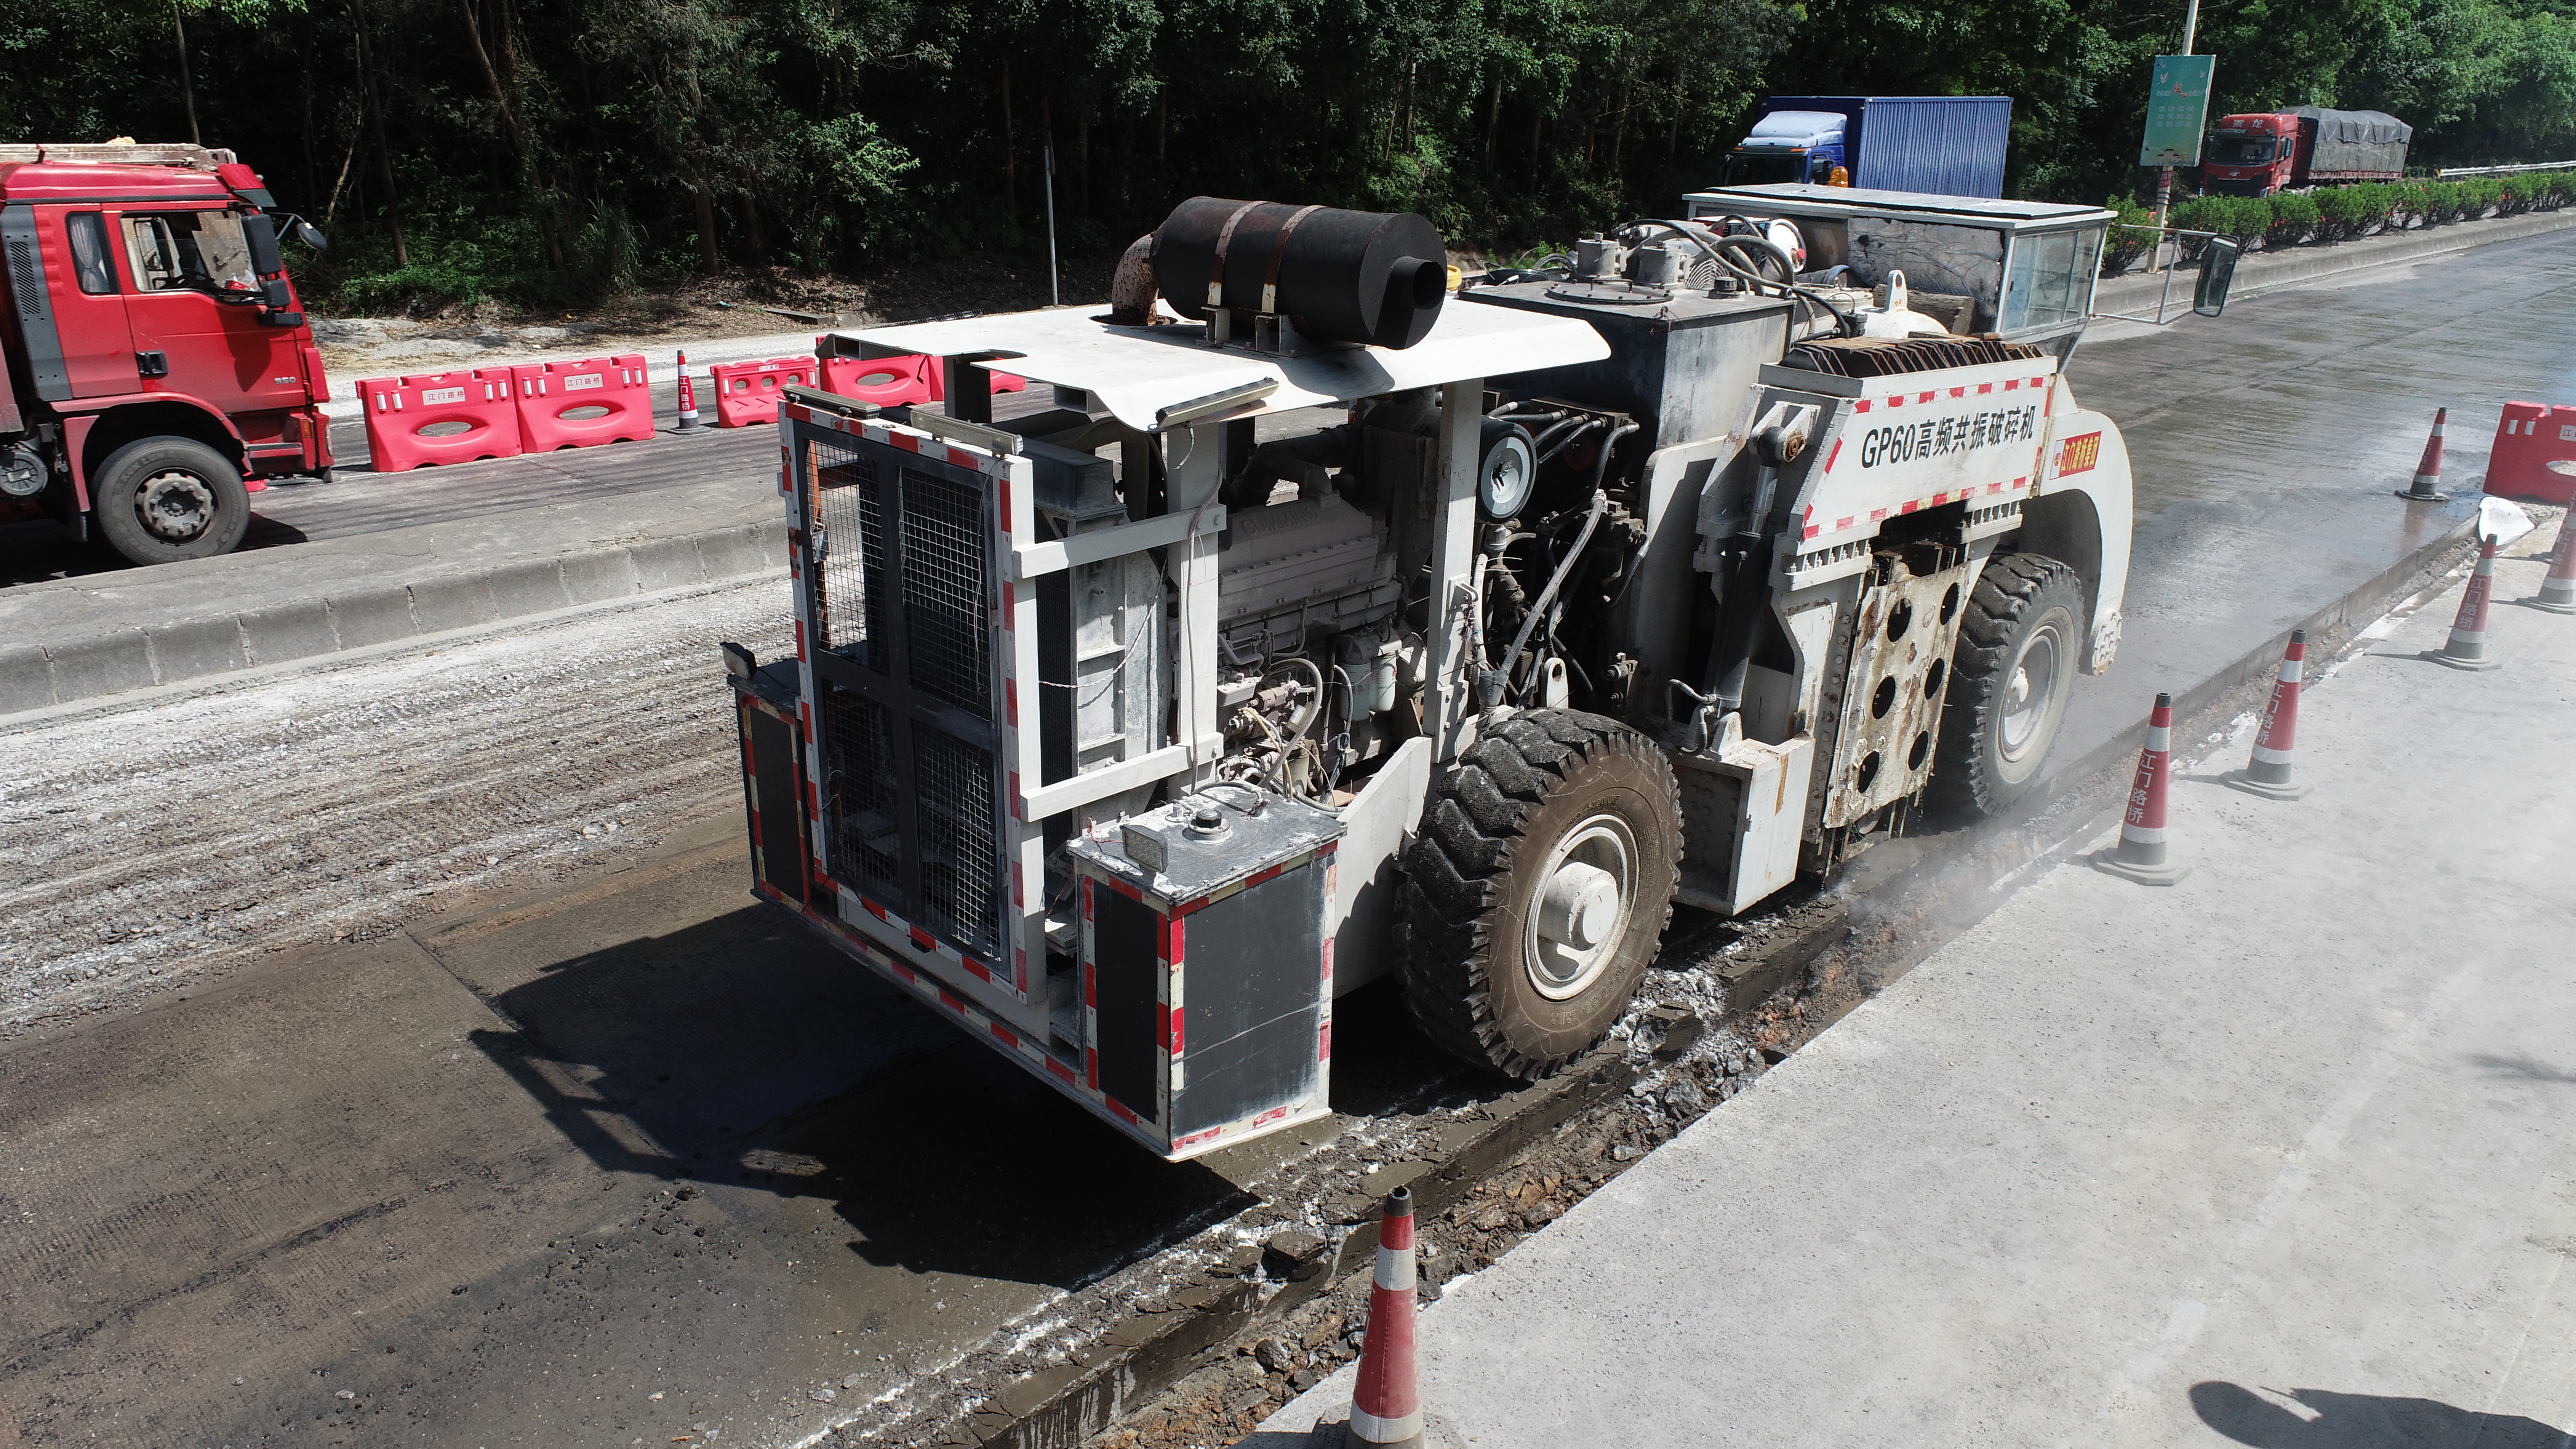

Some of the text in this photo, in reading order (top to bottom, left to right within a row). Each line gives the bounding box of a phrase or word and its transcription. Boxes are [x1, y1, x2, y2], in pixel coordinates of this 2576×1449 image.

[274, 376, 296, 385] 950
[428, 390, 464, 401] 江门路桥
[567, 377, 600, 387] 江门路桥
[680, 377, 691, 411] 江门路桥
[1861, 405, 2036, 468] GP60高频共振破碎机
[2061, 436, 2100, 472] 江门路桥集团
[2459, 577, 2486, 629] 江门路桥
[2127, 752, 2157, 824] 江门路桥
